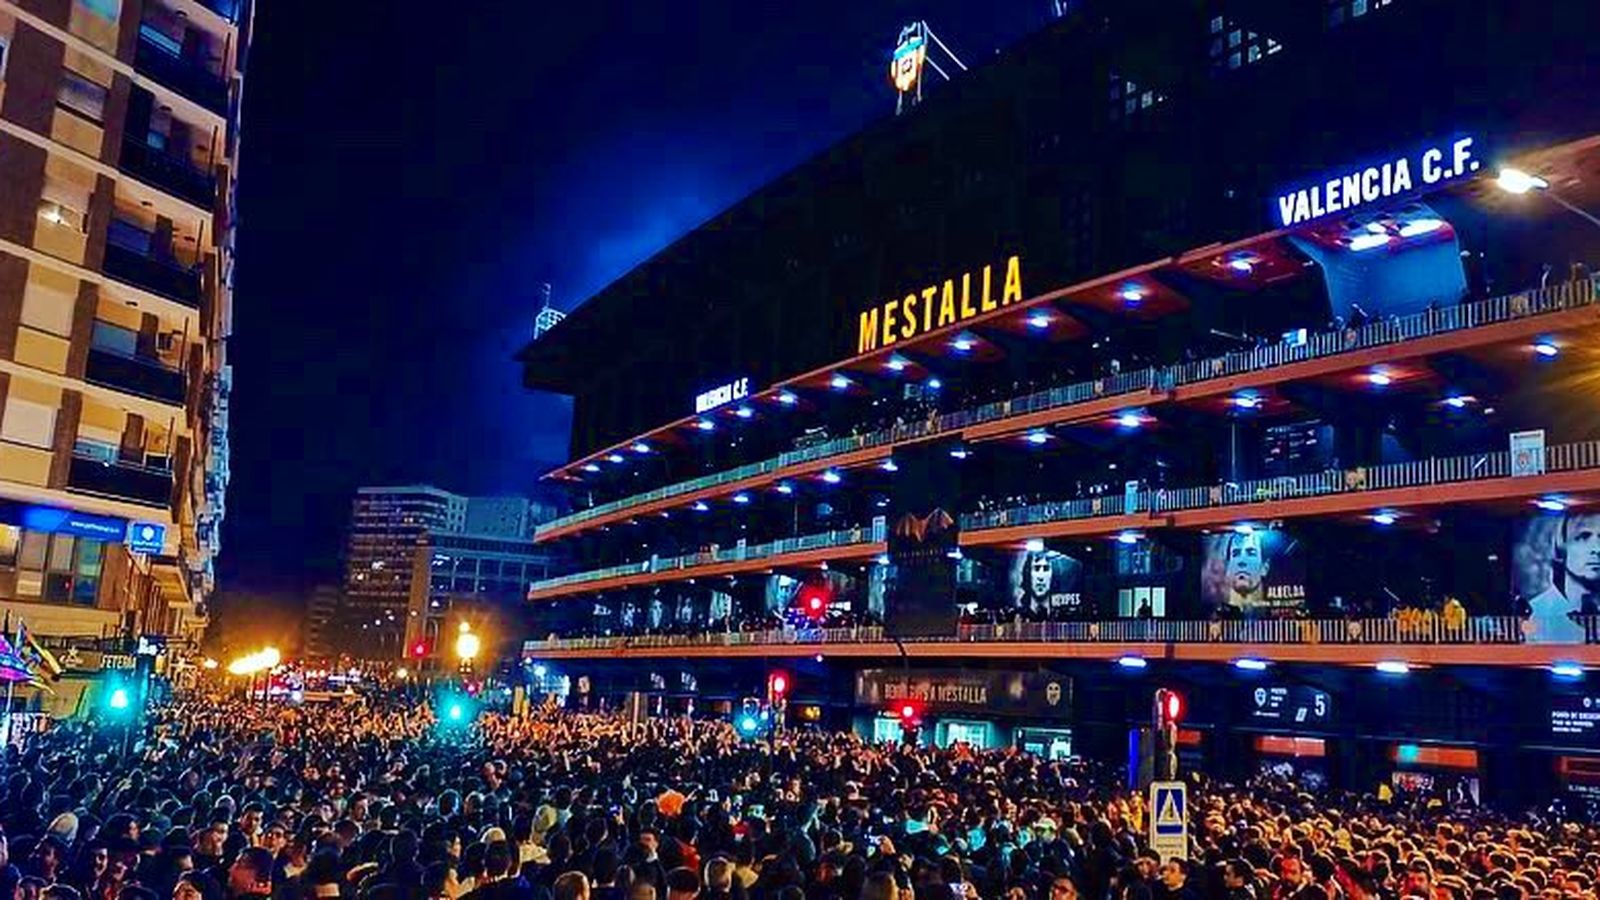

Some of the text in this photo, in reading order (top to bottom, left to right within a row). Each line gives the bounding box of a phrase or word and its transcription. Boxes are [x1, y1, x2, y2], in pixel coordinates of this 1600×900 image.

[1278, 137, 1480, 227] VALENCIA C.F.
[858, 256, 1023, 354] MESTALLA
[1314, 693, 1326, 716] 5
